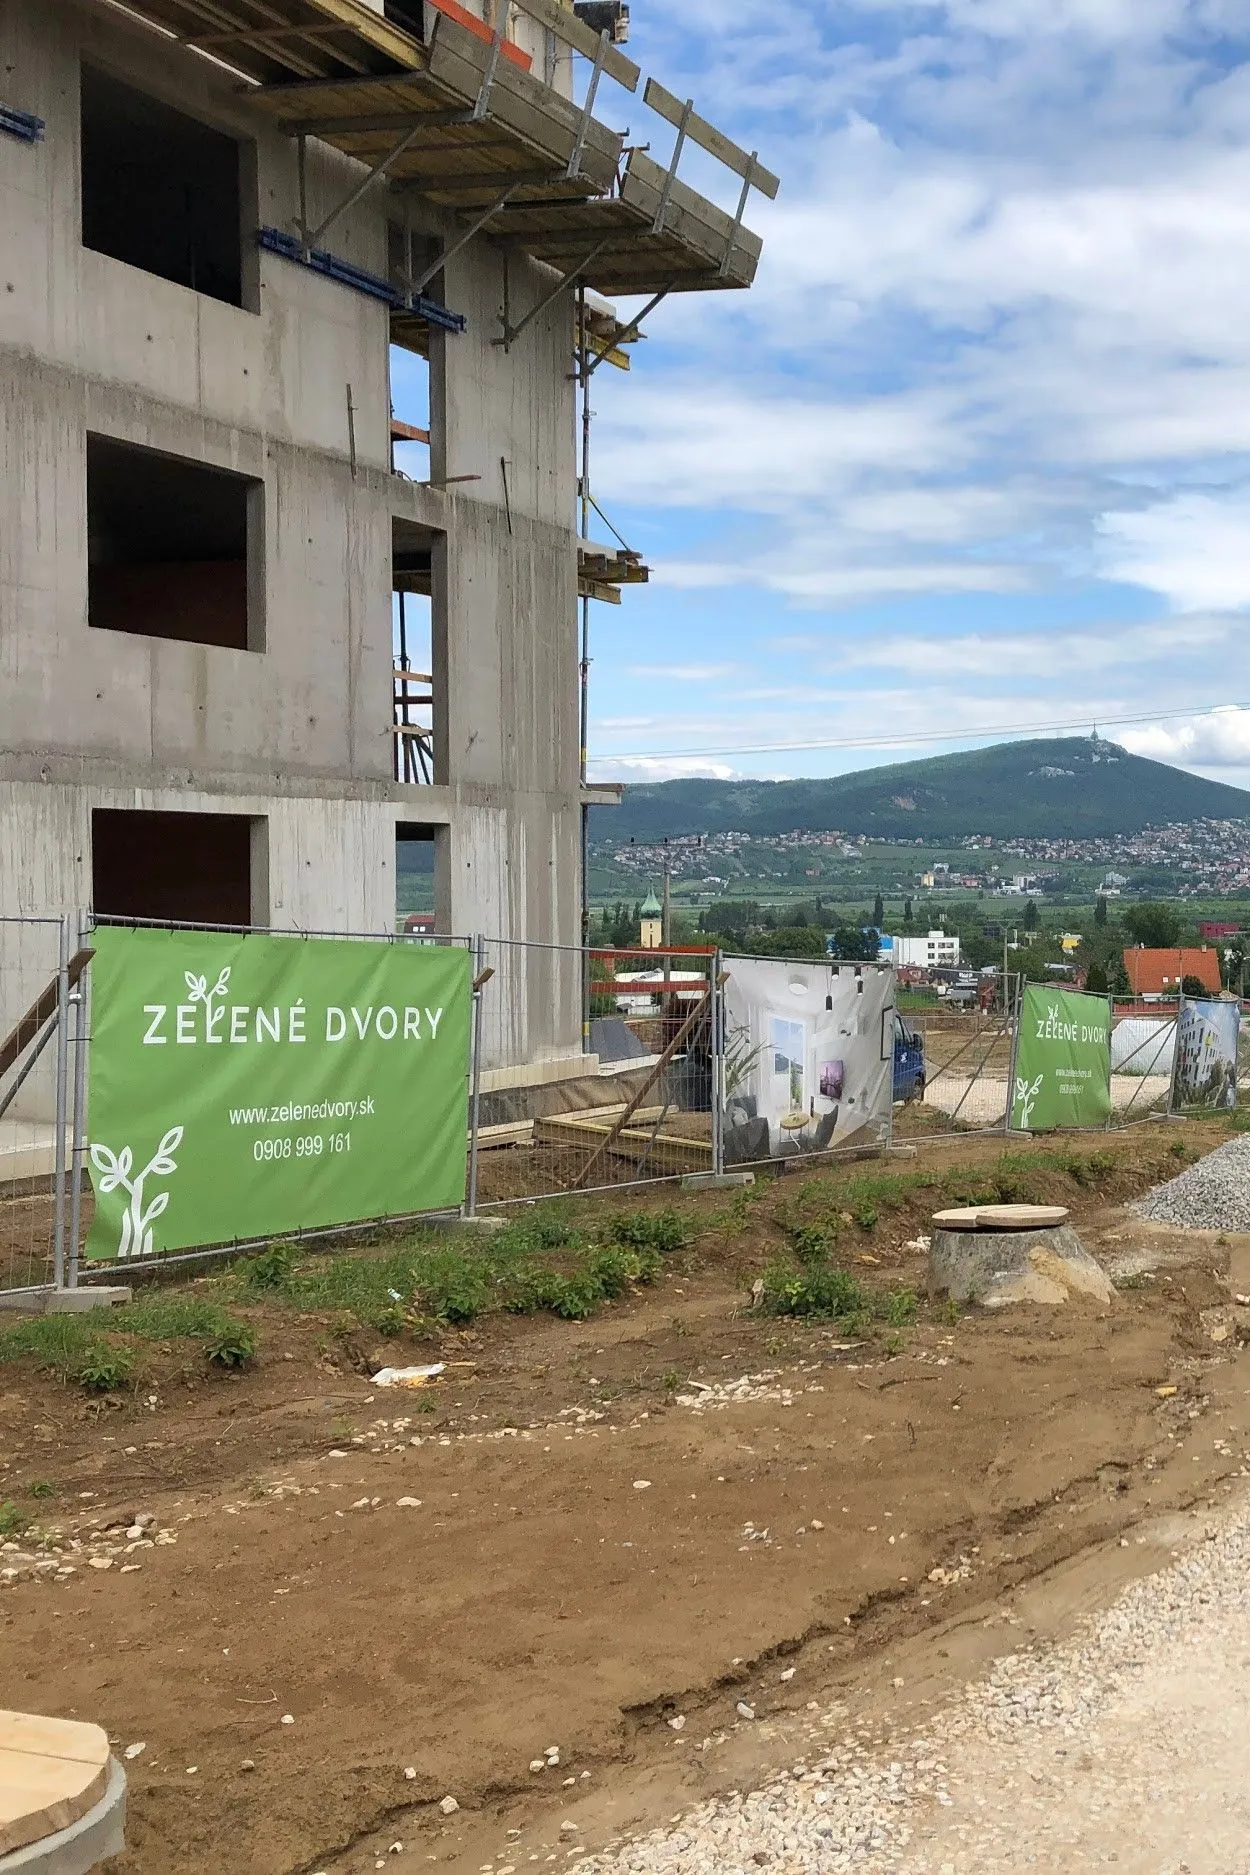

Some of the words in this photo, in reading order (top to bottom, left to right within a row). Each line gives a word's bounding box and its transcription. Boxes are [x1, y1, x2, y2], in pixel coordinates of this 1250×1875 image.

[142, 998, 307, 1044] ZELENÉ
[325, 1005, 443, 1042] DVORY
[1036, 1020, 1078, 1042] ZELENÉ
[229, 1095, 375, 1125] www.zelenedvory.sk
[253, 1137, 292, 1161] 0908
[296, 1135, 323, 1157] 999
[328, 1132, 351, 1153] 161
